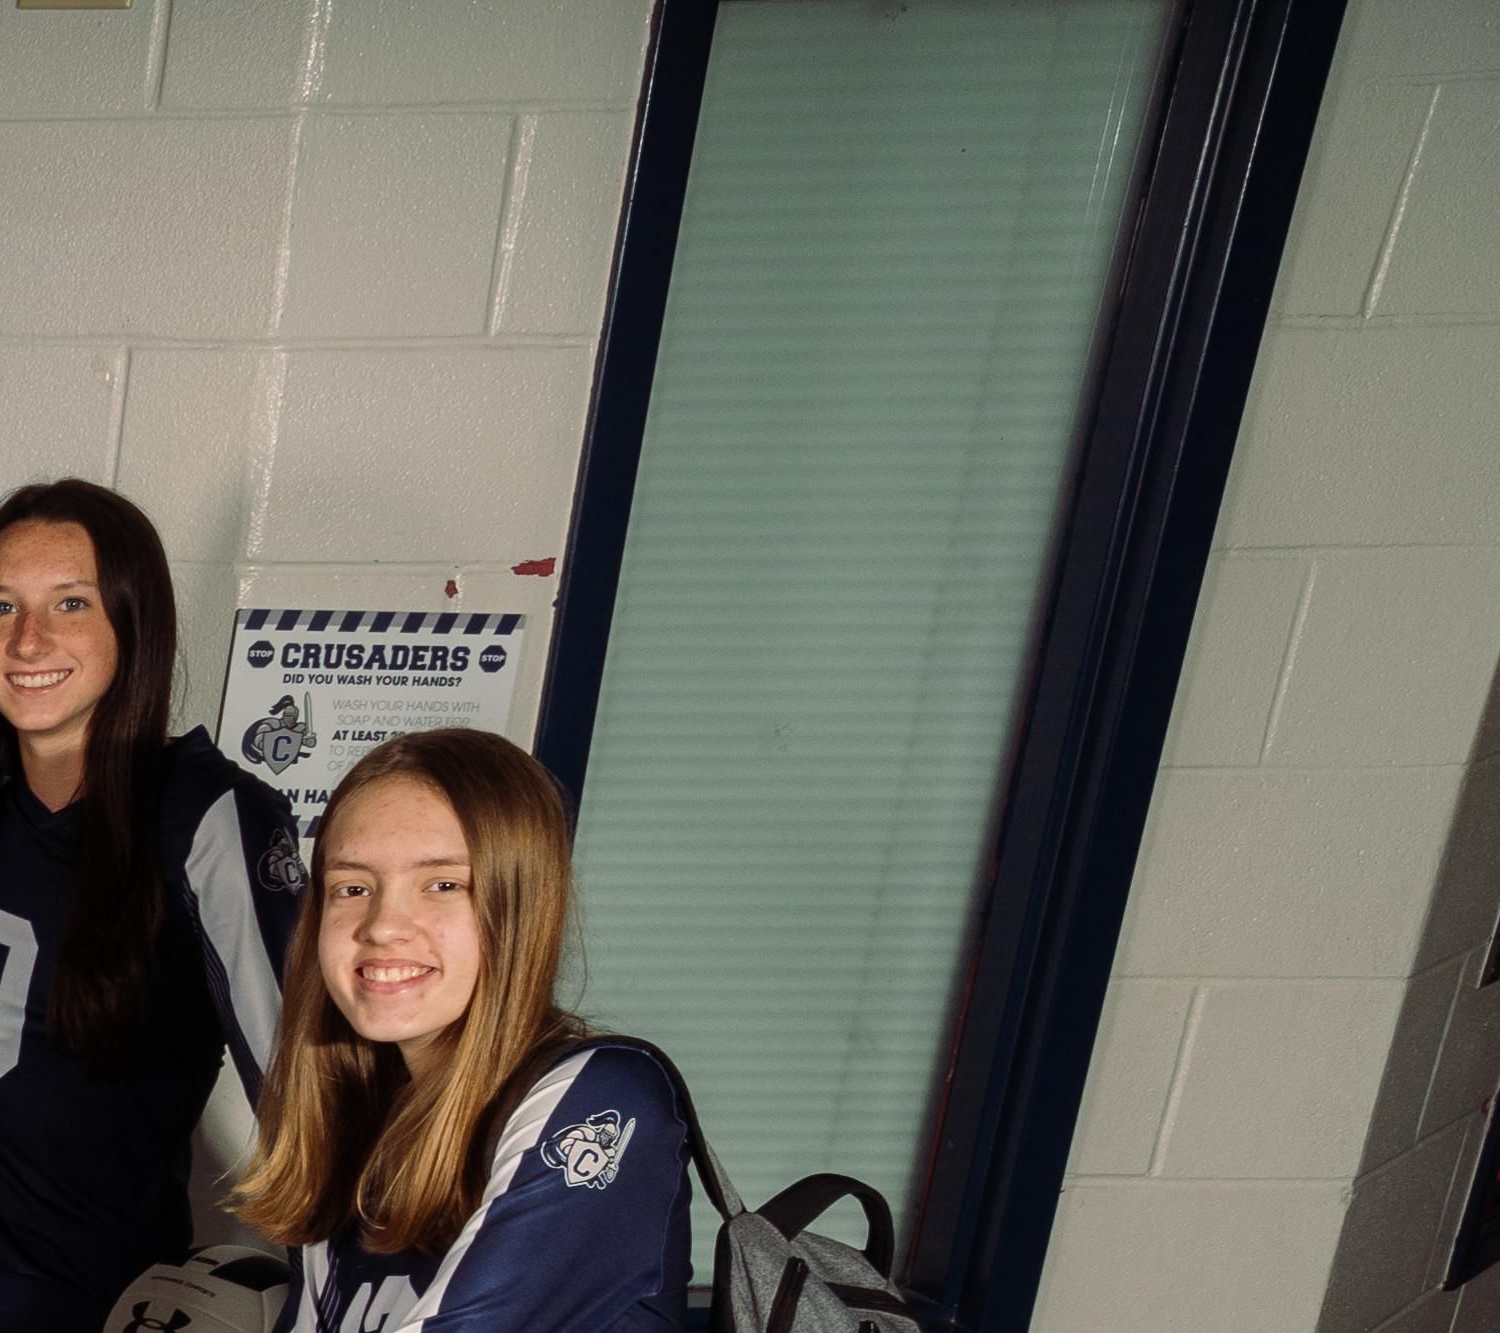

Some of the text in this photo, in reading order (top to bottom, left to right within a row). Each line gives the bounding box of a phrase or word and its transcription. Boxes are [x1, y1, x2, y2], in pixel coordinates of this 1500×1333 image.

[249, 649, 274, 659] STOP
[280, 643, 471, 672] CRUSADERS
[481, 654, 506, 663] STOP
[283, 674, 462, 687] DID YOU WASH YOUR HANDS?
[332, 700, 480, 712] WASH YOUR HANDS WITH
[336, 714, 371, 726] SOAP
[372, 716, 400, 726] AND
[403, 716, 443, 727] WATER
[332, 731, 348, 741] AT
[351, 731, 388, 741] LEAST
